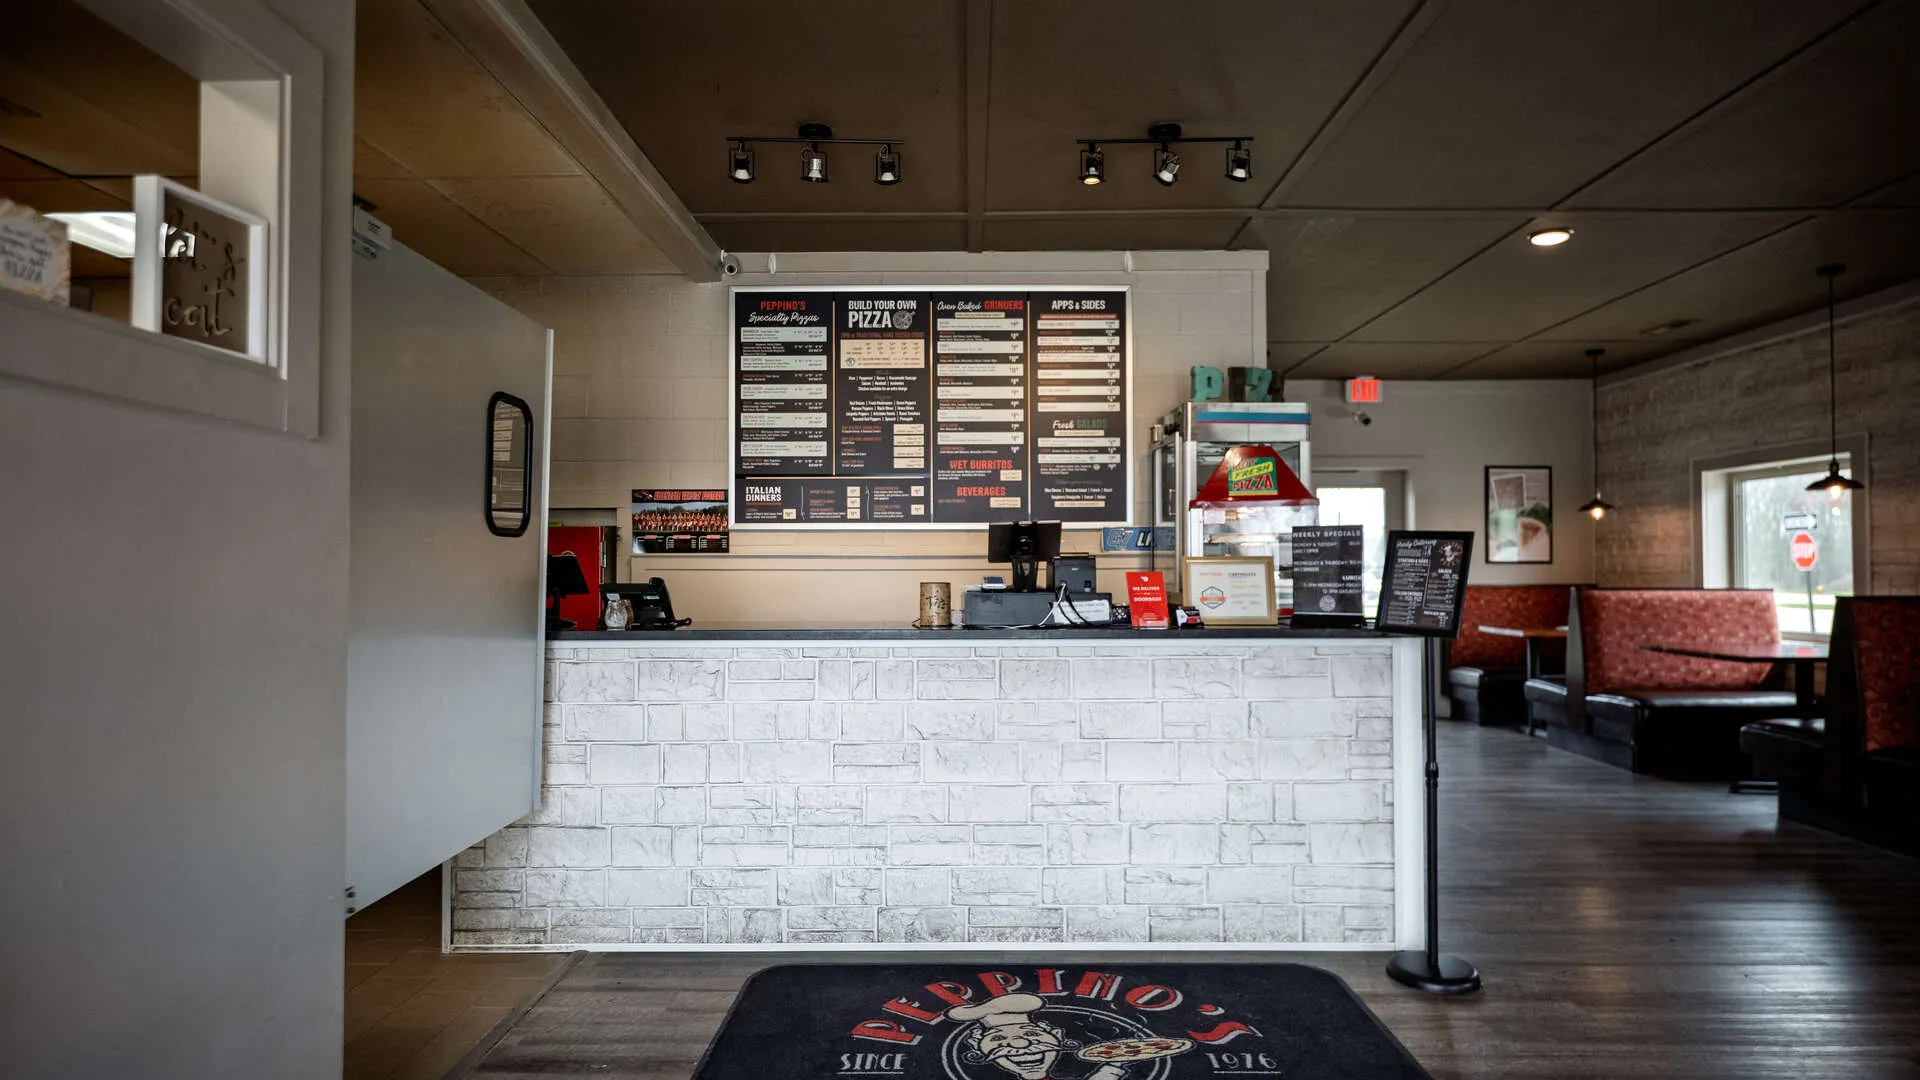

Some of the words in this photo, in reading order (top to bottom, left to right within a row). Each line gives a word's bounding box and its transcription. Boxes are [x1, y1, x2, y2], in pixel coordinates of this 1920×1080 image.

[760, 301, 806, 310] PEPPINO'S
[848, 300, 873, 310] BUILD
[874, 300, 896, 310] YOUR
[897, 300, 918, 310] OWN
[937, 301, 956, 310] Oven
[958, 301, 982, 312] Baked
[984, 300, 1024, 310] GRINDERS
[1052, 300, 1074, 310] APPS
[1075, 302, 1080, 310] &
[1081, 300, 1106, 310] SIDES
[748, 312, 790, 325] Specialty
[790, 312, 820, 325] Pizzas
[848, 311, 892, 328] PIZZA
[1351, 379, 1380, 402] EXIT
[1052, 420, 1074, 429] Fresh
[949, 460, 968, 470] WET
[970, 460, 1013, 470] BURRITOS
[1234, 463, 1271, 480] FRESH
[1233, 474, 1274, 490] PIZZA
[957, 486, 1006, 496] BEVERAGES
[849, 968, 1263, 1046] PEPPINO'S
[839, 1052, 908, 1070] SINCE
[1206, 1052, 1279, 1070] 1976
